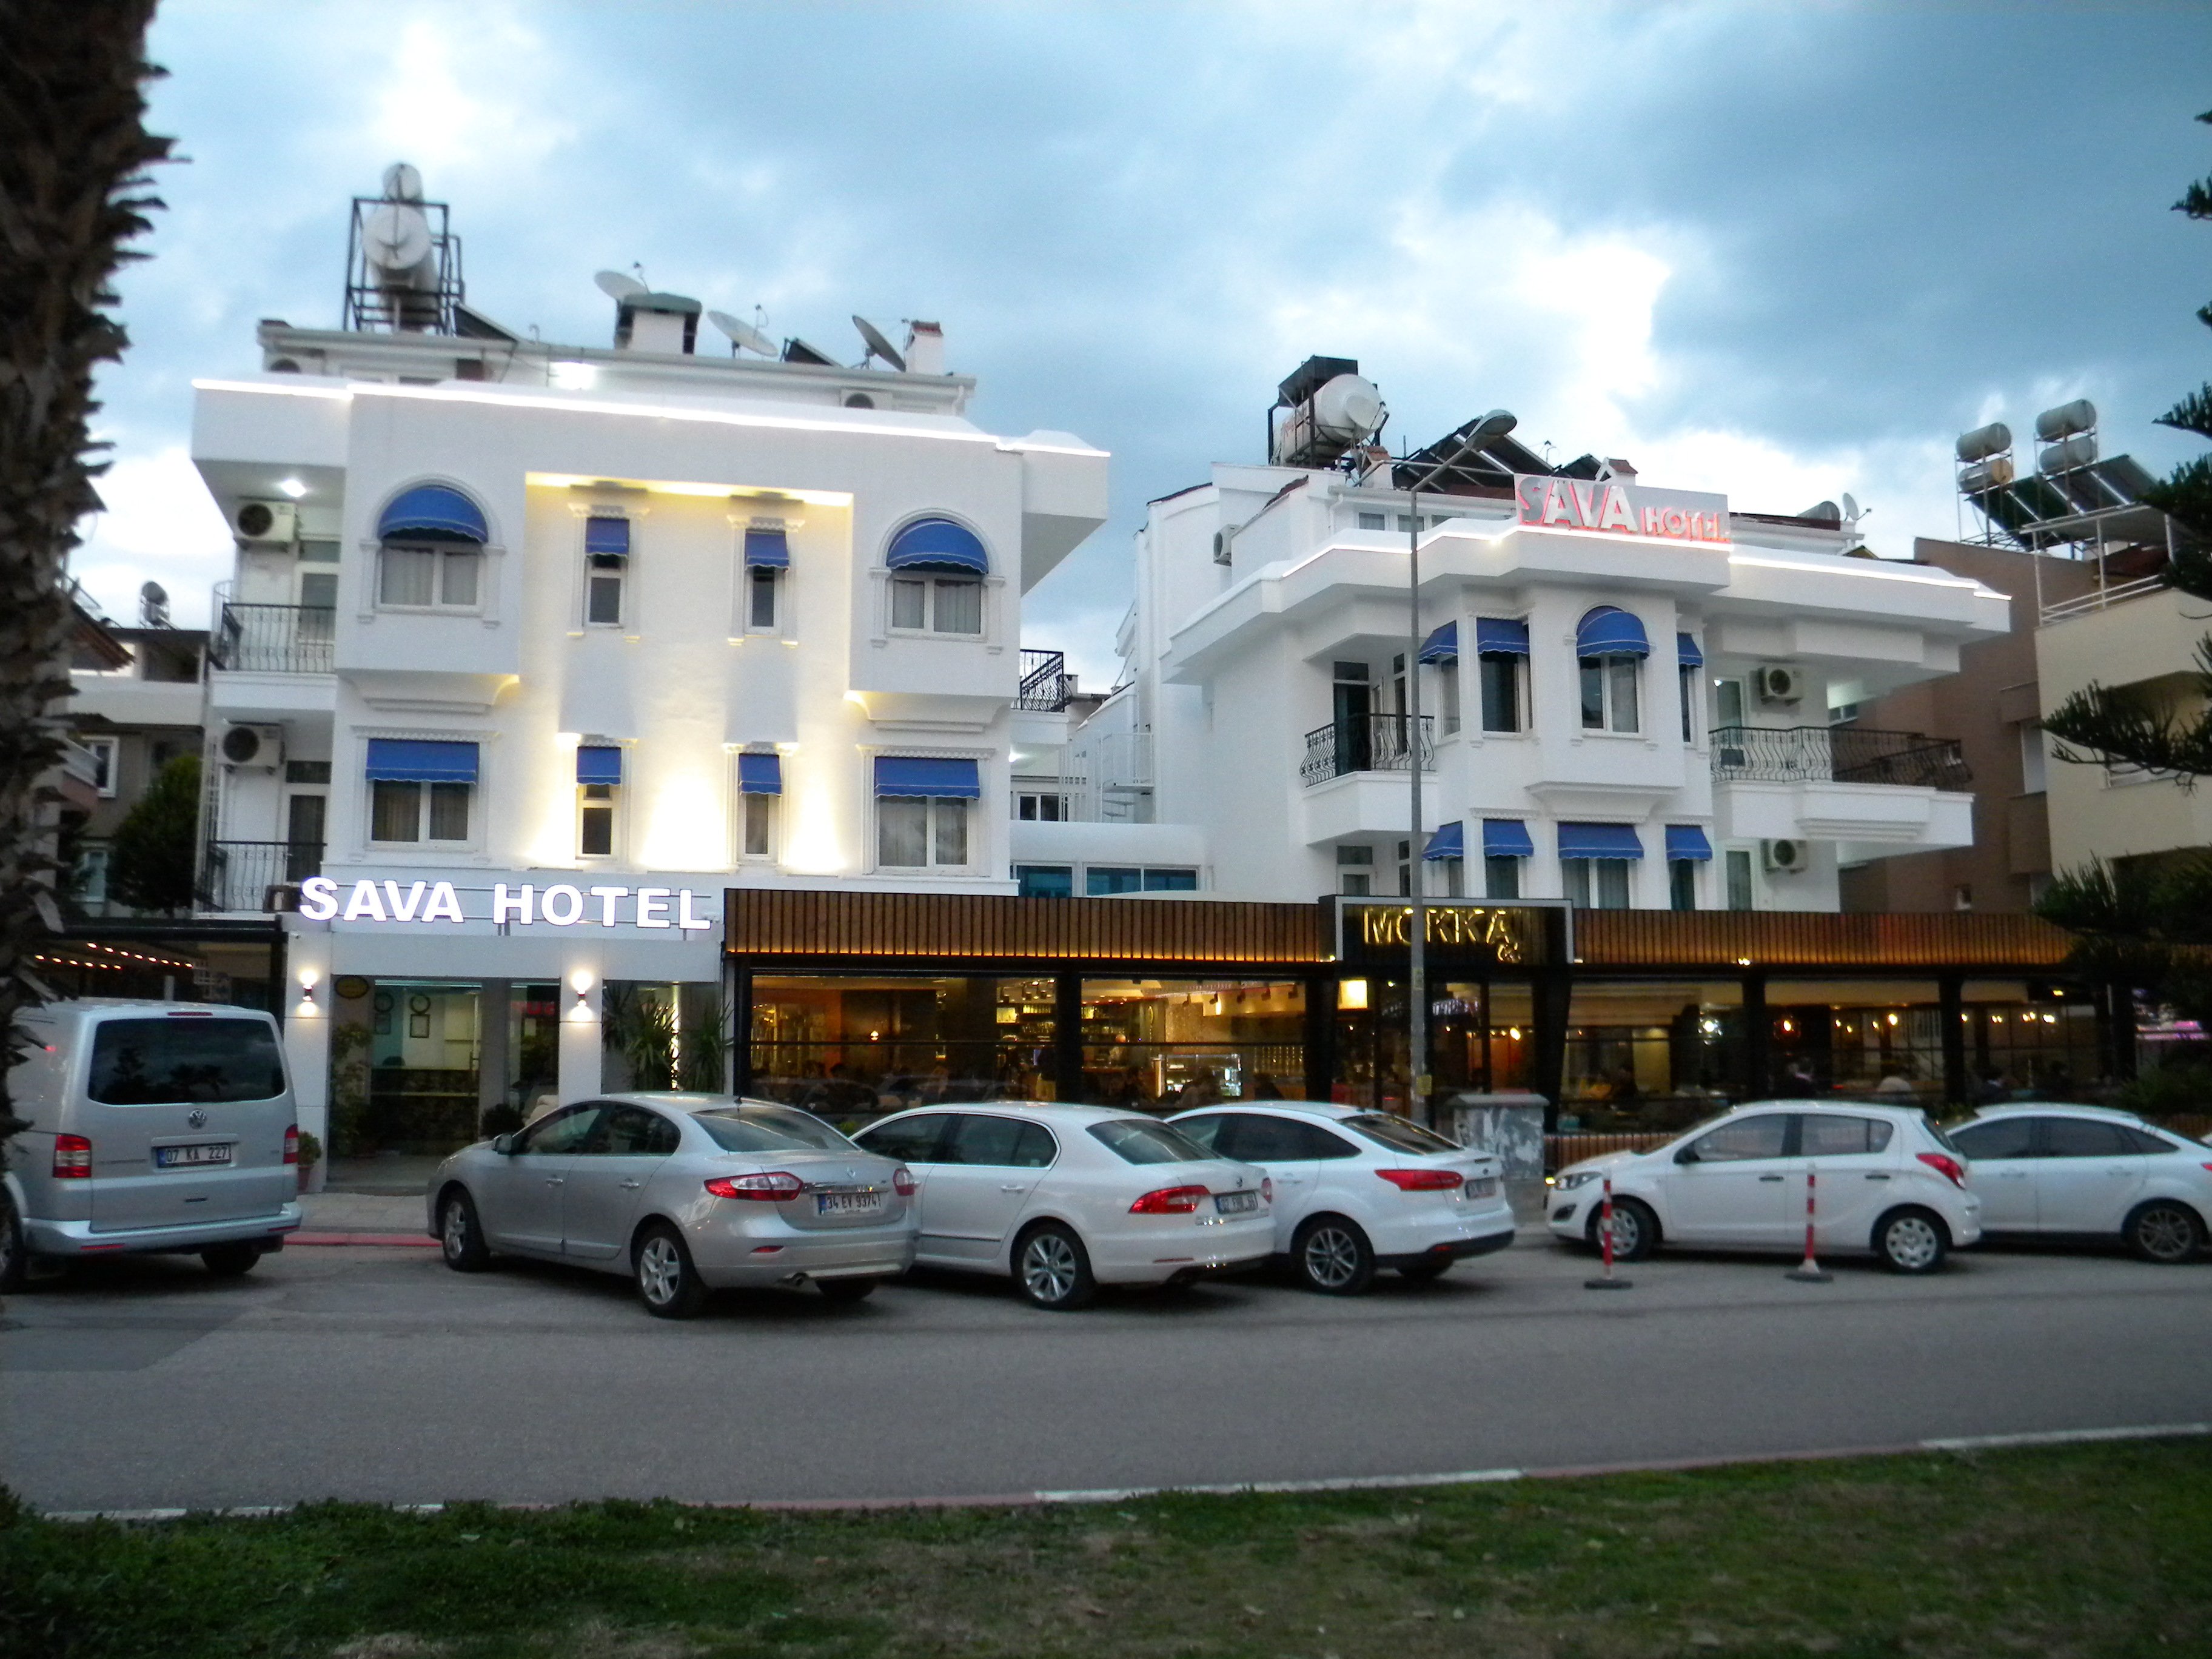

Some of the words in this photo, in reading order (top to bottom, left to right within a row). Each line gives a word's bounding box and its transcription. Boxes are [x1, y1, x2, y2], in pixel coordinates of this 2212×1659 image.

[1517, 475, 1638, 534] SAVA
[1640, 506, 1731, 543] HOTEL
[300, 876, 466, 924] SAVA
[492, 882, 712, 930] HOTEL
[166, 1148, 179, 1162] 07
[208, 1145, 227, 1160] 227
[826, 1196, 839, 1209] 34
